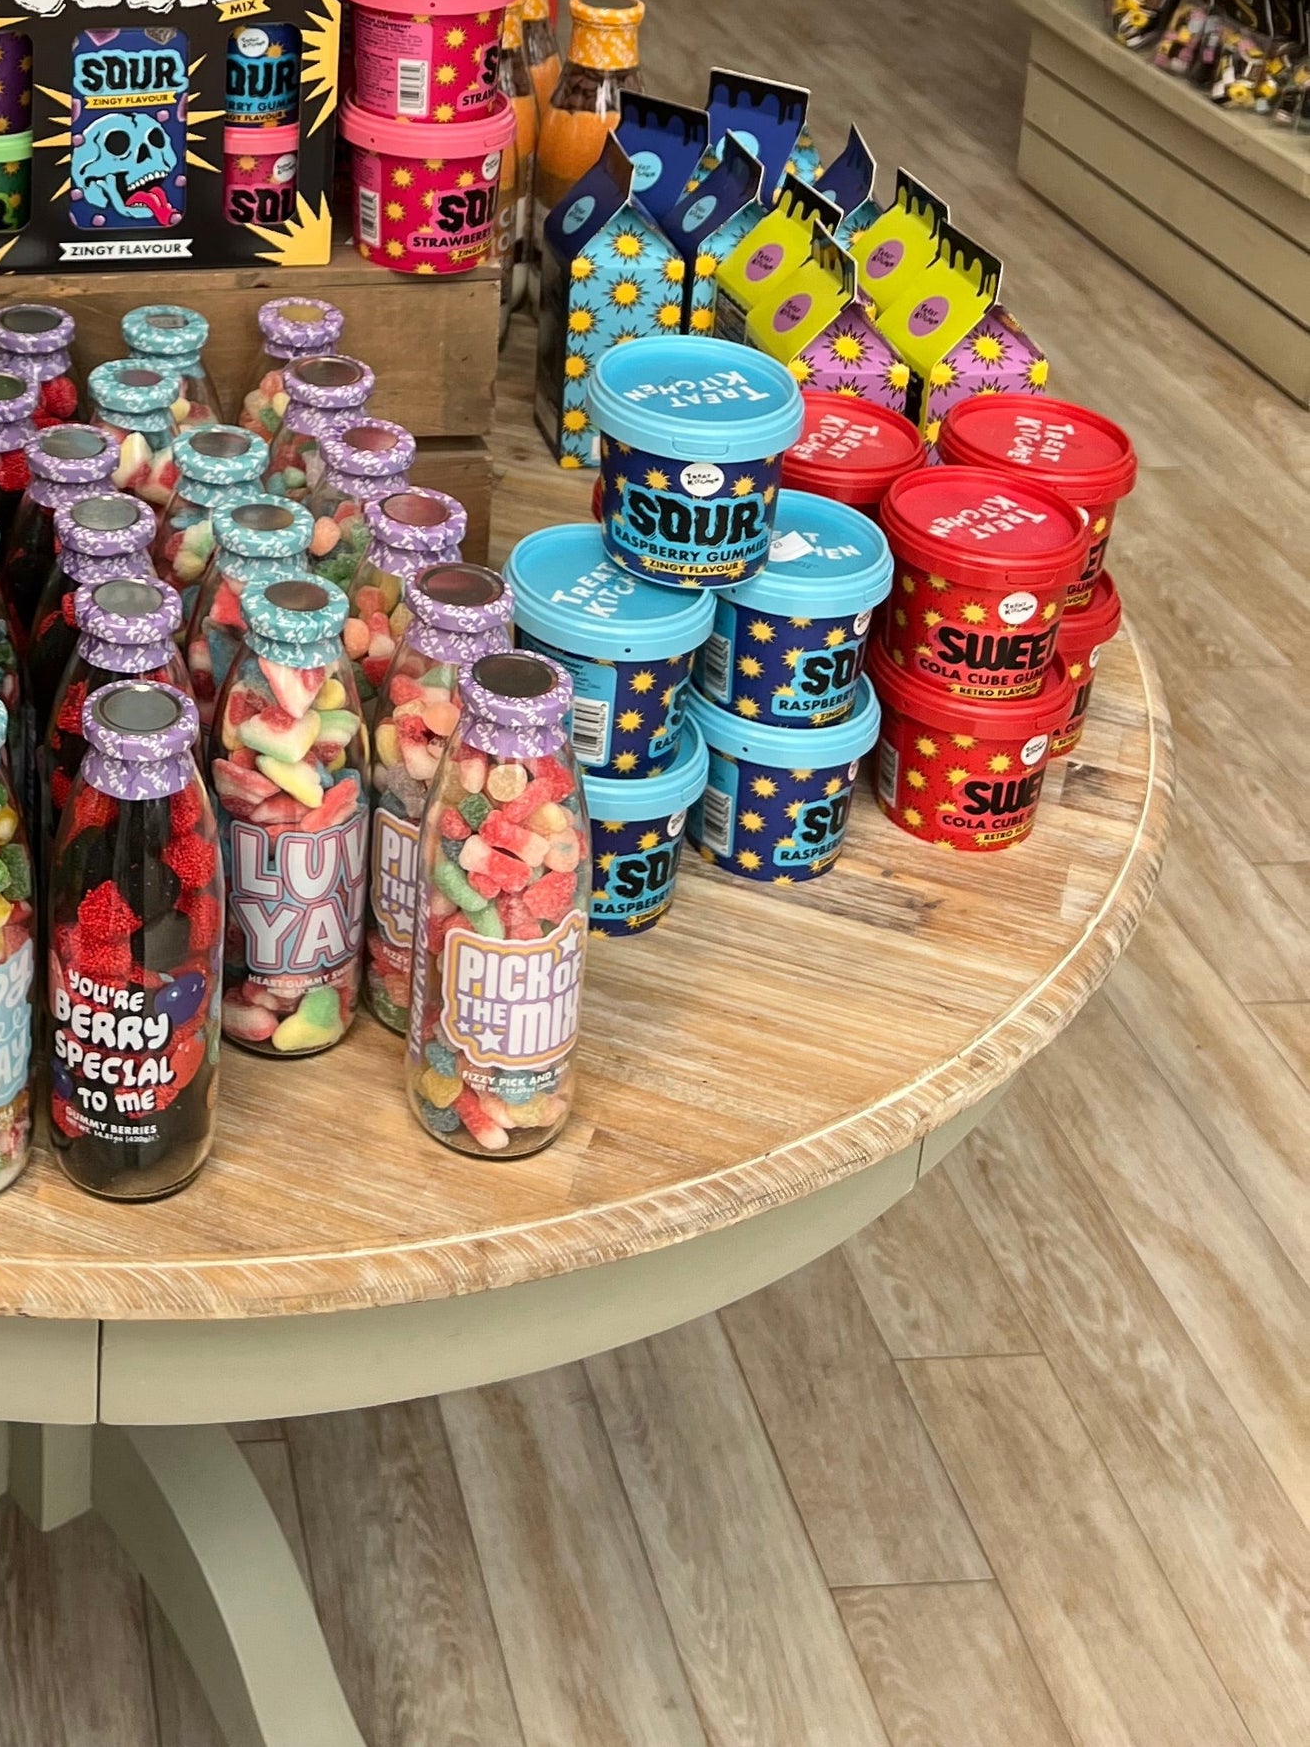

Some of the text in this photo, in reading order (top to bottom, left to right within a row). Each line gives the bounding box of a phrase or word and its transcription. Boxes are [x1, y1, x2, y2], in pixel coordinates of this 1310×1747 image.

[230, 0, 257, 15] MIX
[82, 55, 185, 92] SOUR
[226, 59, 299, 97] OUR
[92, 93, 169, 106] ZINGY FLAVOUR
[71, 243, 182, 256] ZINGY FLAVOUR
[622, 370, 748, 402] KITCHEN
[670, 385, 771, 408] TREAT
[826, 423, 880, 460] TREAT
[1040, 424, 1075, 463] TREAT
[627, 488, 763, 548] SOUR
[927, 494, 1019, 538] KITCHEN
[969, 507, 1048, 540] TREAT
[614, 526, 700, 563] RASPBERRY
[706, 536, 769, 563] GUMMIES
[649, 559, 739, 574] ZINGY FLAVOUR
[551, 561, 618, 605] TREAT
[919, 657, 962, 681] COLA
[967, 672, 1009, 686] CUBE
[959, 681, 1038, 697] RETRO FLAVOUR
[942, 812, 1025, 829] COLA CUBE
[983, 830, 1013, 841] RETRO
[248, 973, 328, 989] HEART GUMMY
[457, 945, 556, 1002] PICK
[67, 968, 145, 1013] YOU'RE
[54, 990, 170, 1052] BERRY
[457, 993, 578, 1055] THE MIX
[54, 1029, 176, 1088] SPECIAL
[462, 1069, 496, 1085] FIZZY
[498, 1077, 527, 1087] PICK
[529, 1072, 553, 1086] AND
[77, 1086, 109, 1113] TO
[65, 1106, 158, 1135] GUMMY BERRIES
